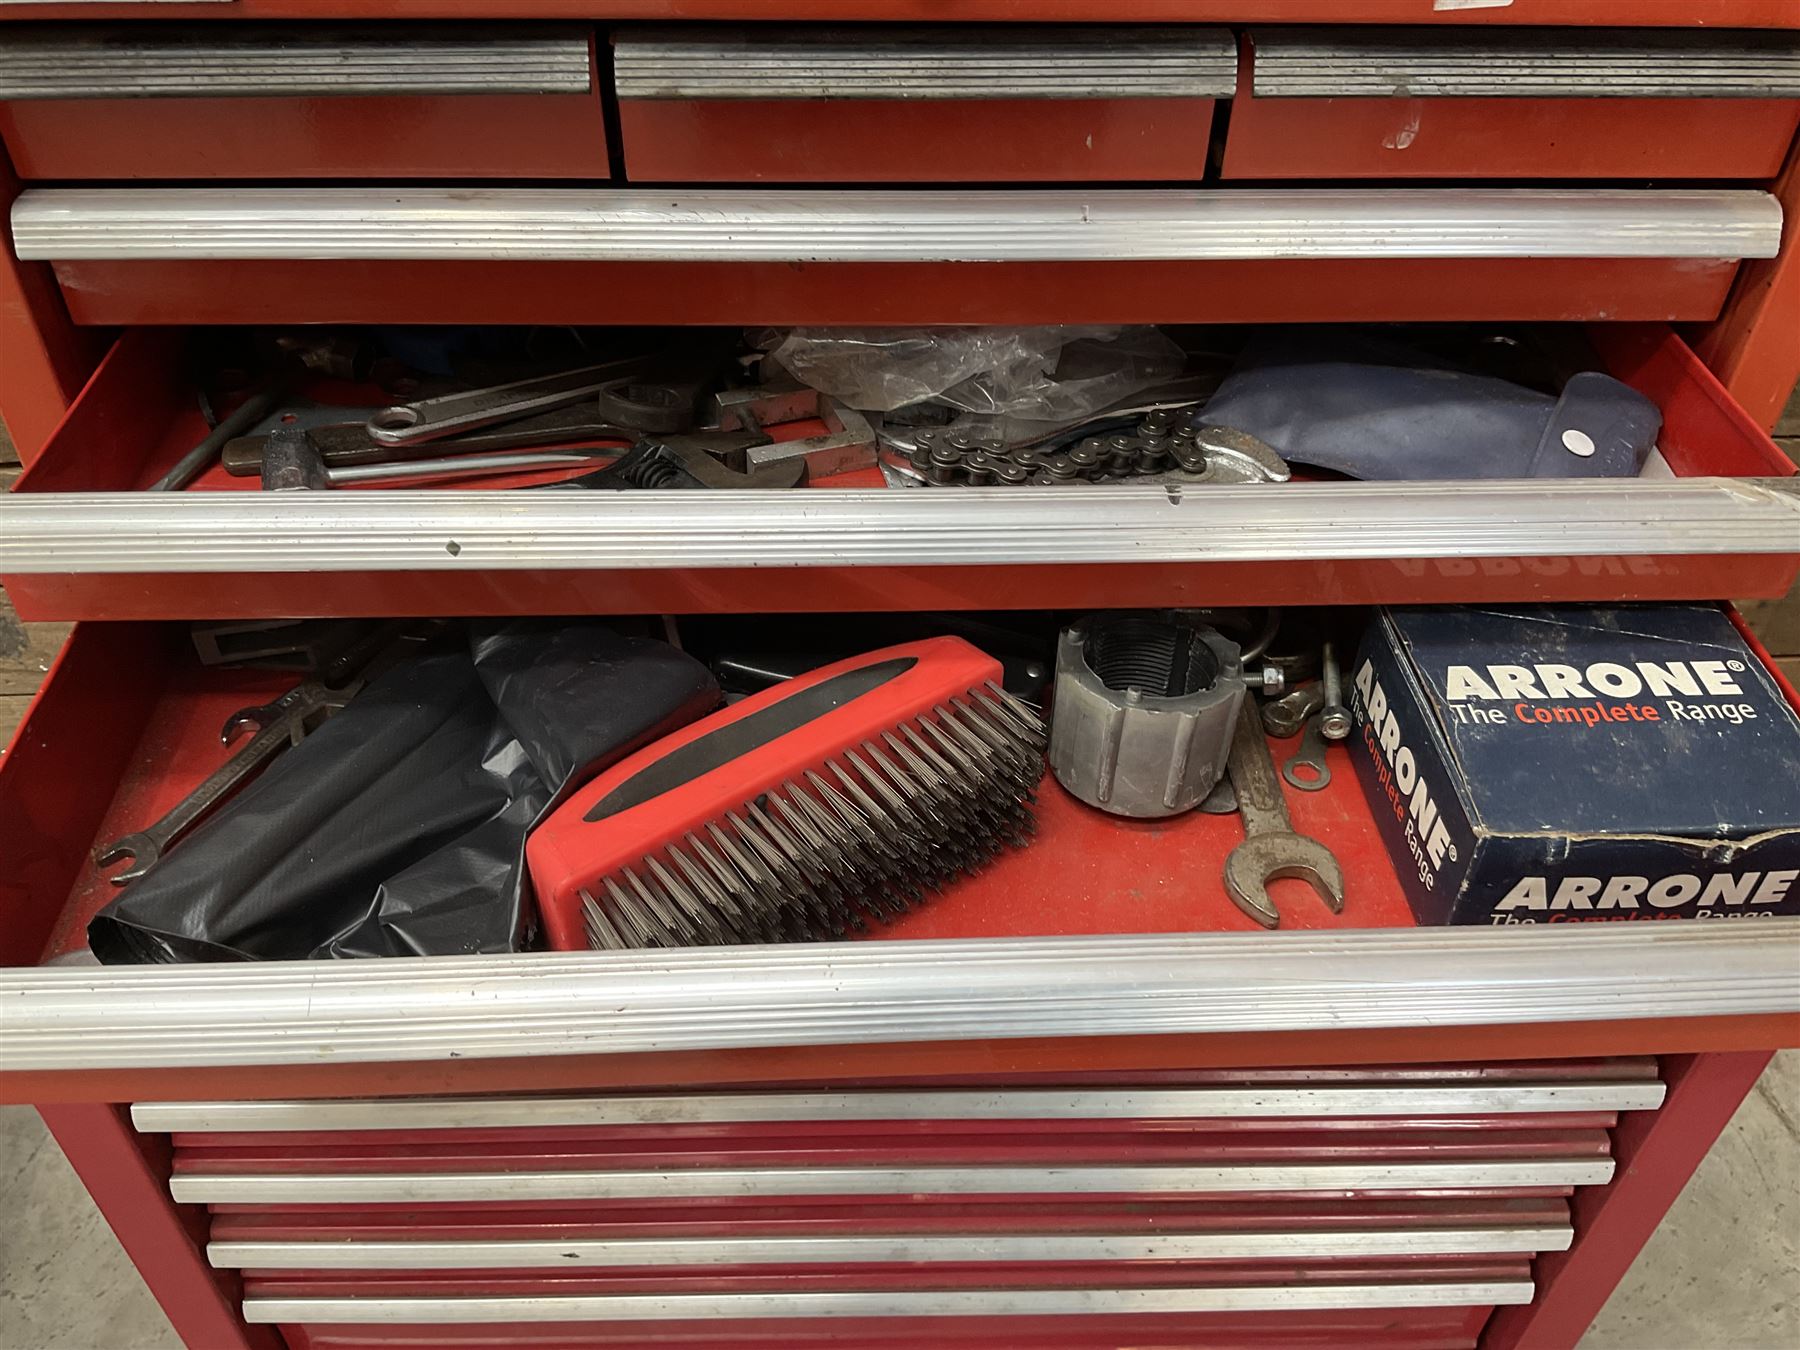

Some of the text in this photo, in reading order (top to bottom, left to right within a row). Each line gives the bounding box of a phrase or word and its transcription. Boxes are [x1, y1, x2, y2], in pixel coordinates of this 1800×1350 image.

[1450, 699, 1758, 728] The Complete Range
[1351, 684, 1435, 892] The Complete Range
[1494, 869, 1800, 911] ARRONE
